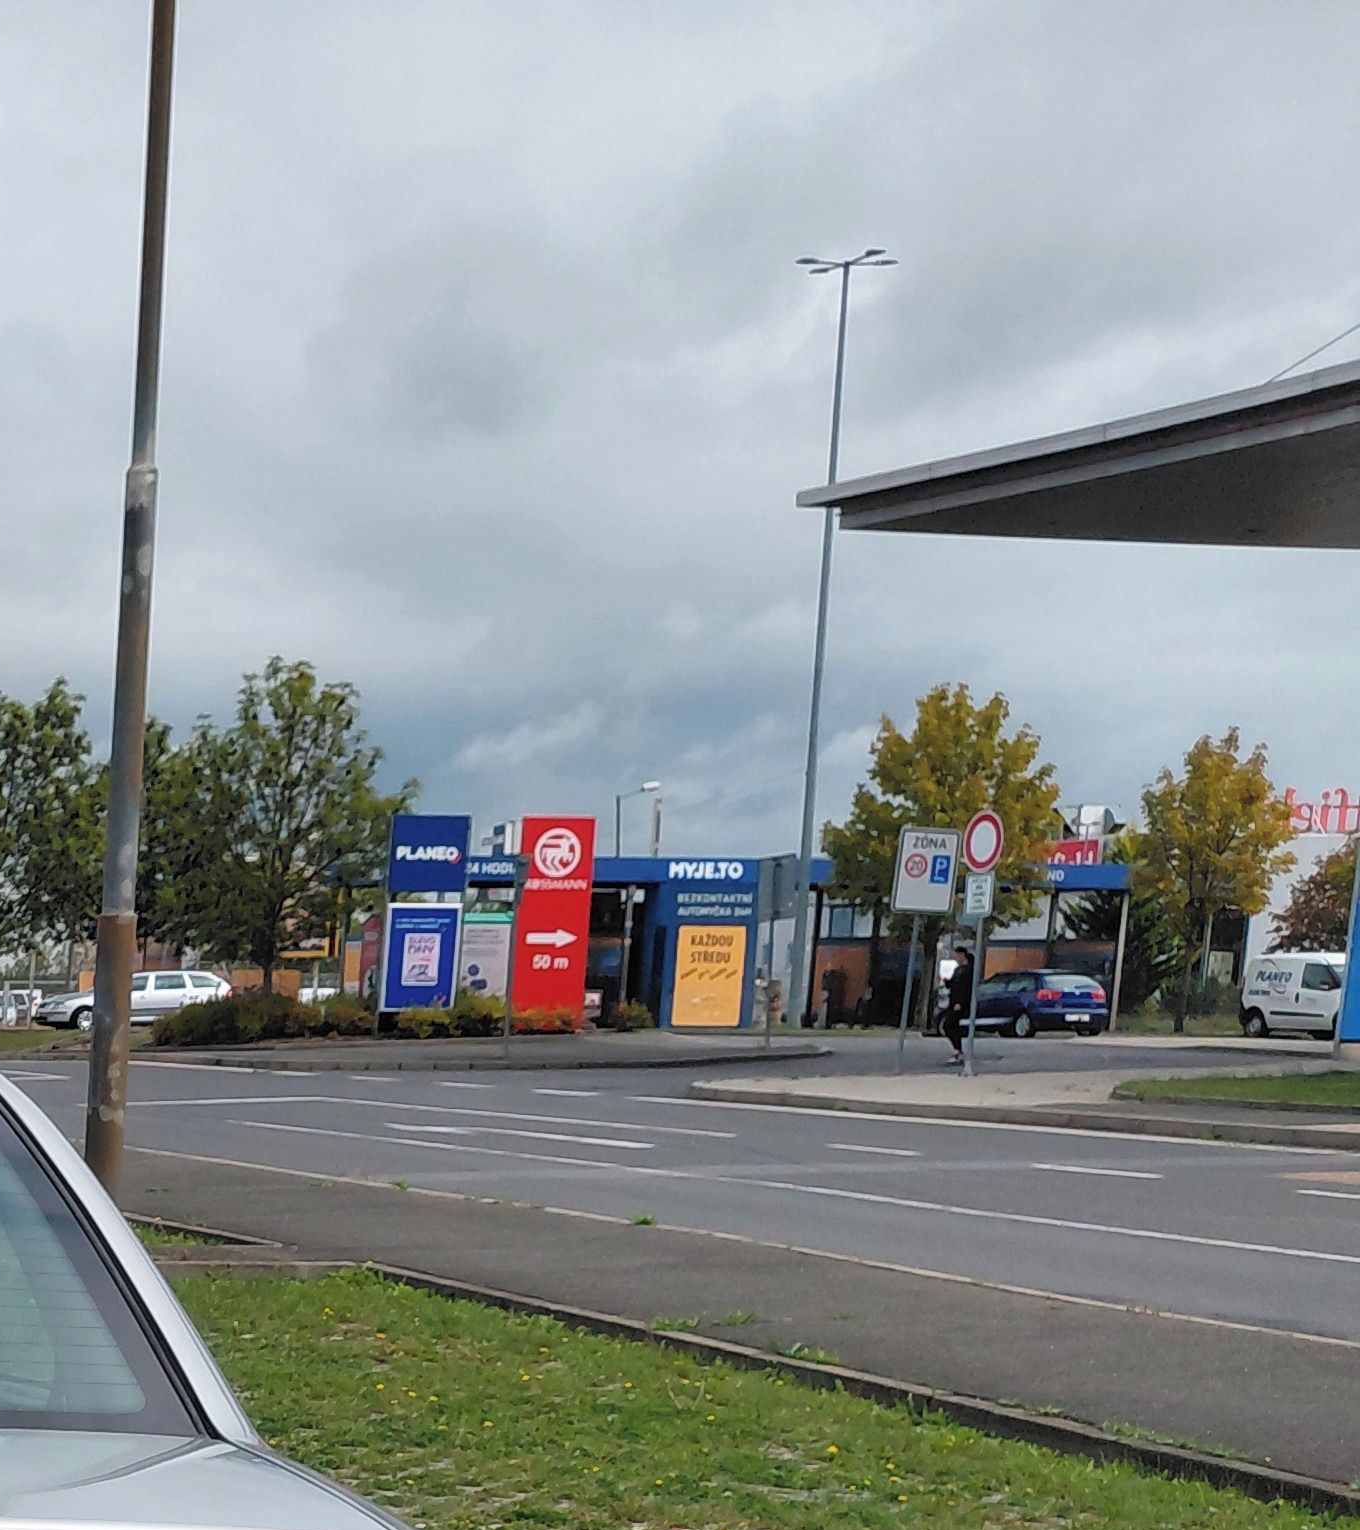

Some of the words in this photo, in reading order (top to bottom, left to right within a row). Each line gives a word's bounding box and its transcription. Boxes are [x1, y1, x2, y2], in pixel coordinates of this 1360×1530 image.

[395, 846, 461, 862] PLANEO
[669, 861, 744, 880] MYJE.TO
[935, 857, 948, 877] P
[690, 933, 734, 946] KAŽDOU
[553, 957, 570, 970] m
